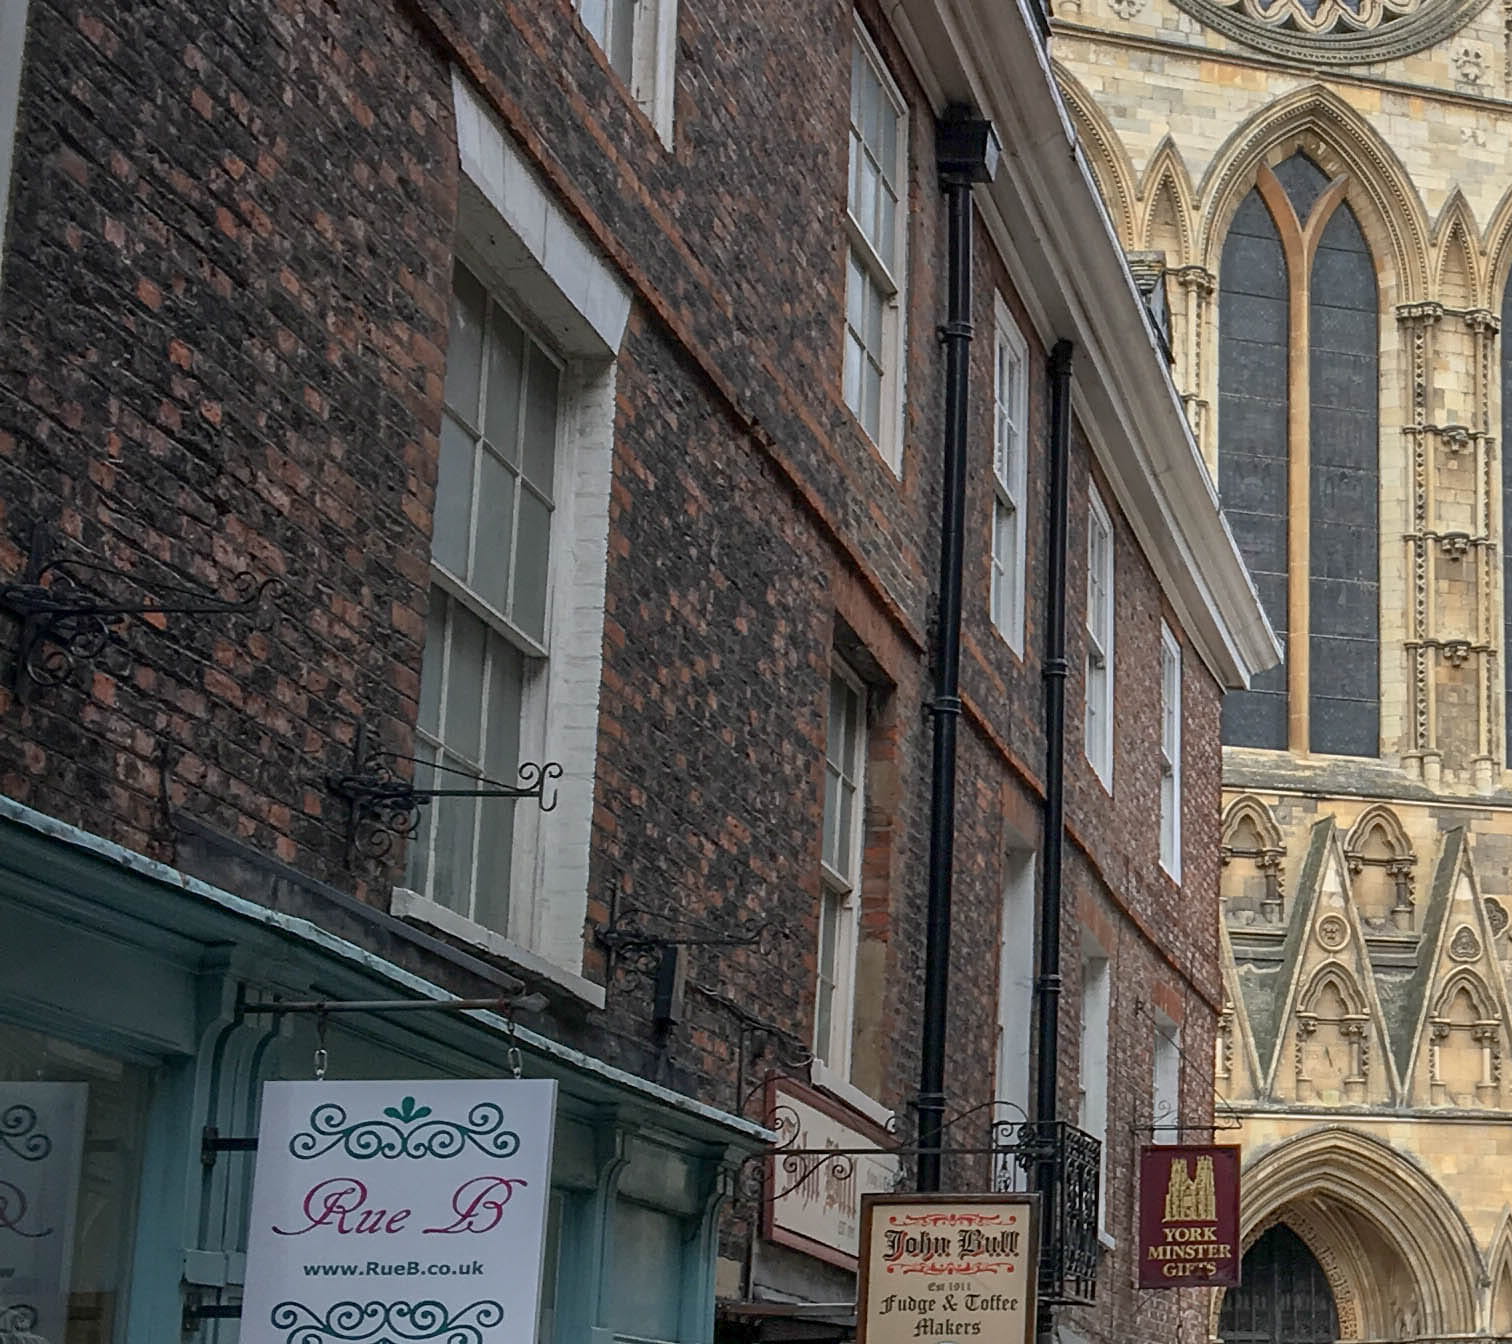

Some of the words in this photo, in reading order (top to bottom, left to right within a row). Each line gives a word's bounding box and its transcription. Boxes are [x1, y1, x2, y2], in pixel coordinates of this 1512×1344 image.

[271, 1176, 411, 1236] Rue
[422, 1176, 528, 1234] B
[1163, 1227, 1217, 1242] YORK
[882, 1229, 951, 1262] John
[957, 1229, 1020, 1261] Bull
[1147, 1244, 1232, 1260] MINSTER
[303, 1259, 484, 1278] www.RueB.co.uk
[1163, 1261, 1217, 1277] GIFTS
[879, 1294, 936, 1315] Fudge
[942, 1294, 958, 1312] &
[965, 1294, 1018, 1312] Toffee
[912, 1318, 981, 1337] Makers
